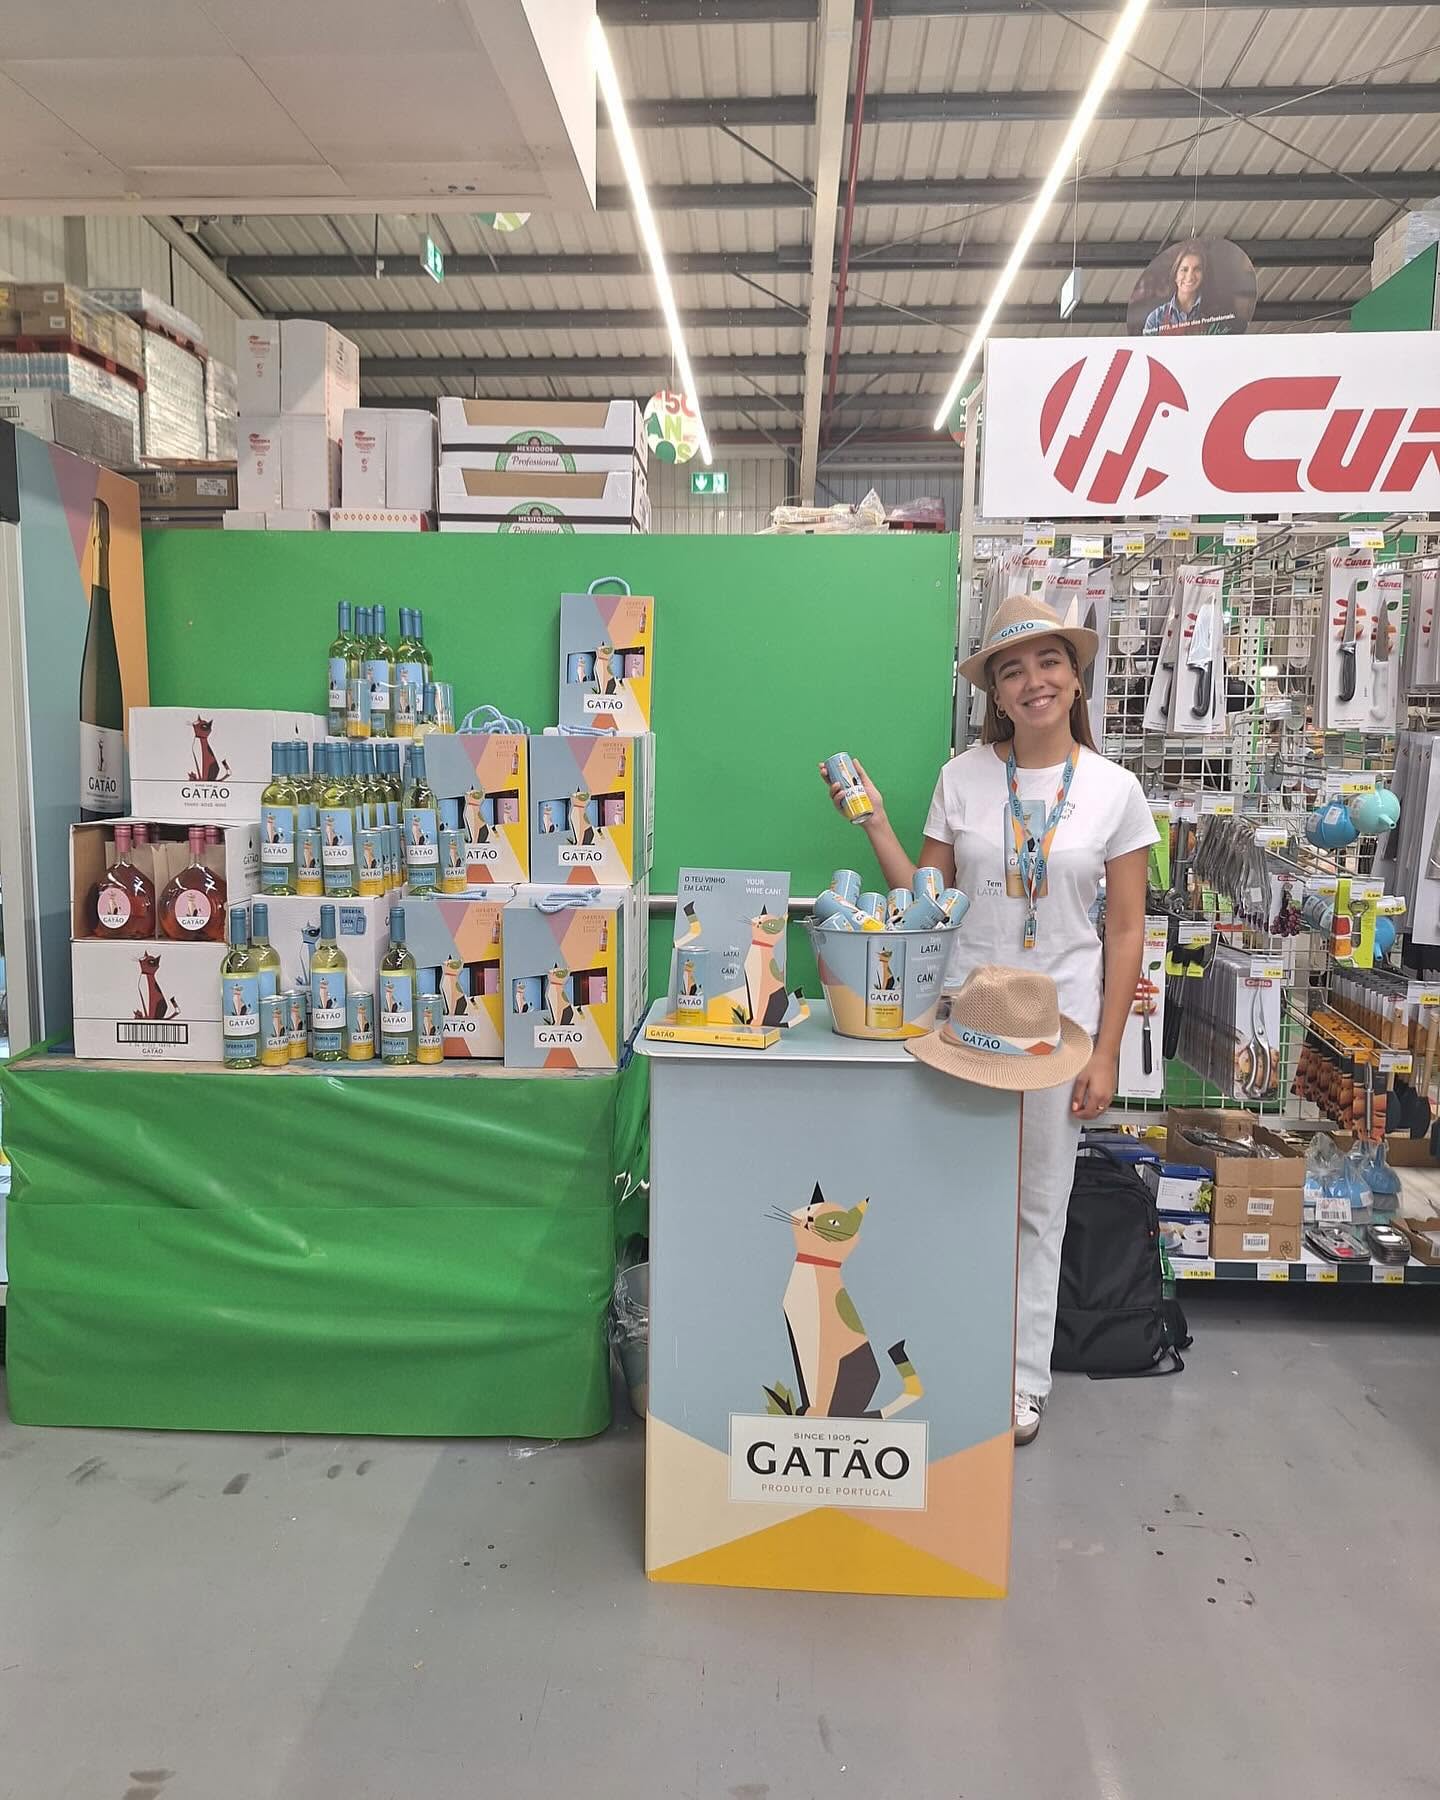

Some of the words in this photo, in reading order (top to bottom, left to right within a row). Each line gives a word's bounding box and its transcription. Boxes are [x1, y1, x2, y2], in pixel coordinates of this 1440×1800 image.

[511, 455, 559, 468] Professional
[587, 698, 624, 710] GATÃO
[88, 776, 117, 793] GATÃO
[181, 785, 230, 799] GATÃO
[467, 847, 498, 859] ATÃO
[562, 849, 602, 862] GATÃO
[695, 885, 713, 893] LATA!
[985, 880, 1002, 888] Tem
[746, 887, 763, 895] WINE
[765, 888, 781, 896] CAN!
[977, 887, 1003, 897] LATA!
[920, 944, 941, 954] LATA!
[870, 992, 900, 1002] GATÃO
[315, 1012, 341, 1020] GATÃO
[229, 1018, 255, 1027] GATÃO
[443, 1020, 476, 1033] ATÃO
[538, 1030, 583, 1043] GATÃO
[650, 1029, 675, 1039] GATÃO
[962, 1032, 1000, 1050] GATÃO
[793, 1432, 825, 1441] SINCE
[827, 1433, 851, 1441] 1905
[746, 1437, 910, 1480] GATÃO
[761, 1483, 813, 1494] PRODUTO
[817, 1486, 831, 1495] DE
[836, 1487, 893, 1497] PORTUGAL
